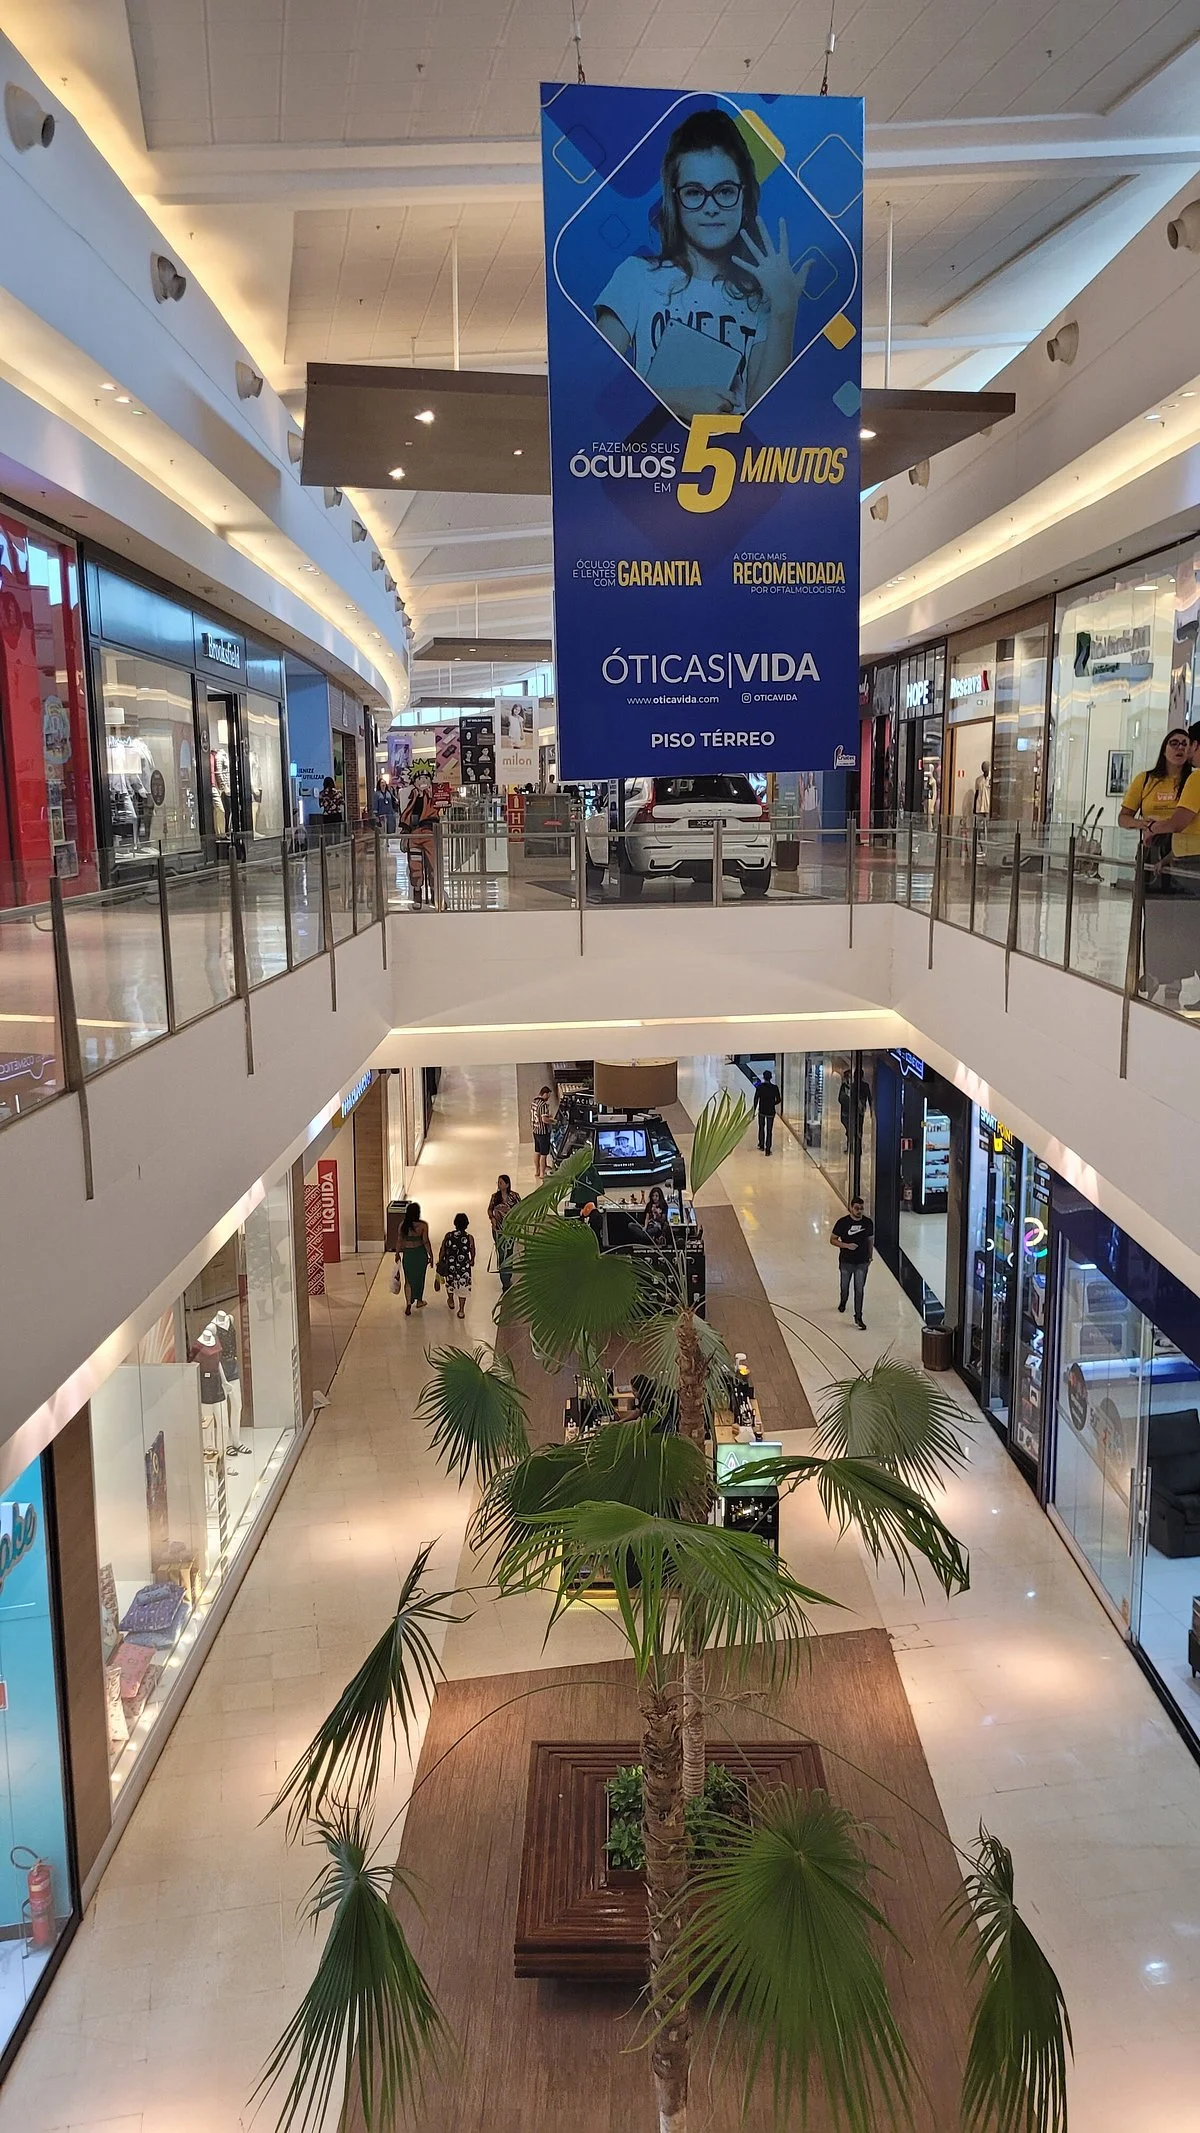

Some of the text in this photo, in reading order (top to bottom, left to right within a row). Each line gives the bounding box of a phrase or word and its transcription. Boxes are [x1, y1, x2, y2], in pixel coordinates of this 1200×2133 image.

[592, 442, 680, 454] FAZEMOS SEUS
[569, 449, 677, 478] ÓCULOS
[676, 414, 744, 514] 5
[739, 446, 848, 485] MINUTOS
[654, 482, 671, 493] EM
[733, 551, 787, 561] A ÓTICA MAIS
[576, 558, 616, 569] ÓCULOS
[573, 569, 616, 579] E LENTES
[617, 560, 702, 587] GARANTIA
[733, 561, 846, 585] RECOMENDADA
[593, 578, 616, 587] COM
[751, 585, 846, 595] POR OFTALMOLOGISTAS
[627, 694, 798, 705] www.oticavida.com OTICAVIDA
[906, 680, 929, 709] HOPE
[651, 728, 776, 749] PISO TÉRREO
[502, 752, 532, 766] milon
[321, 1172, 336, 1233] LIQUIDA
